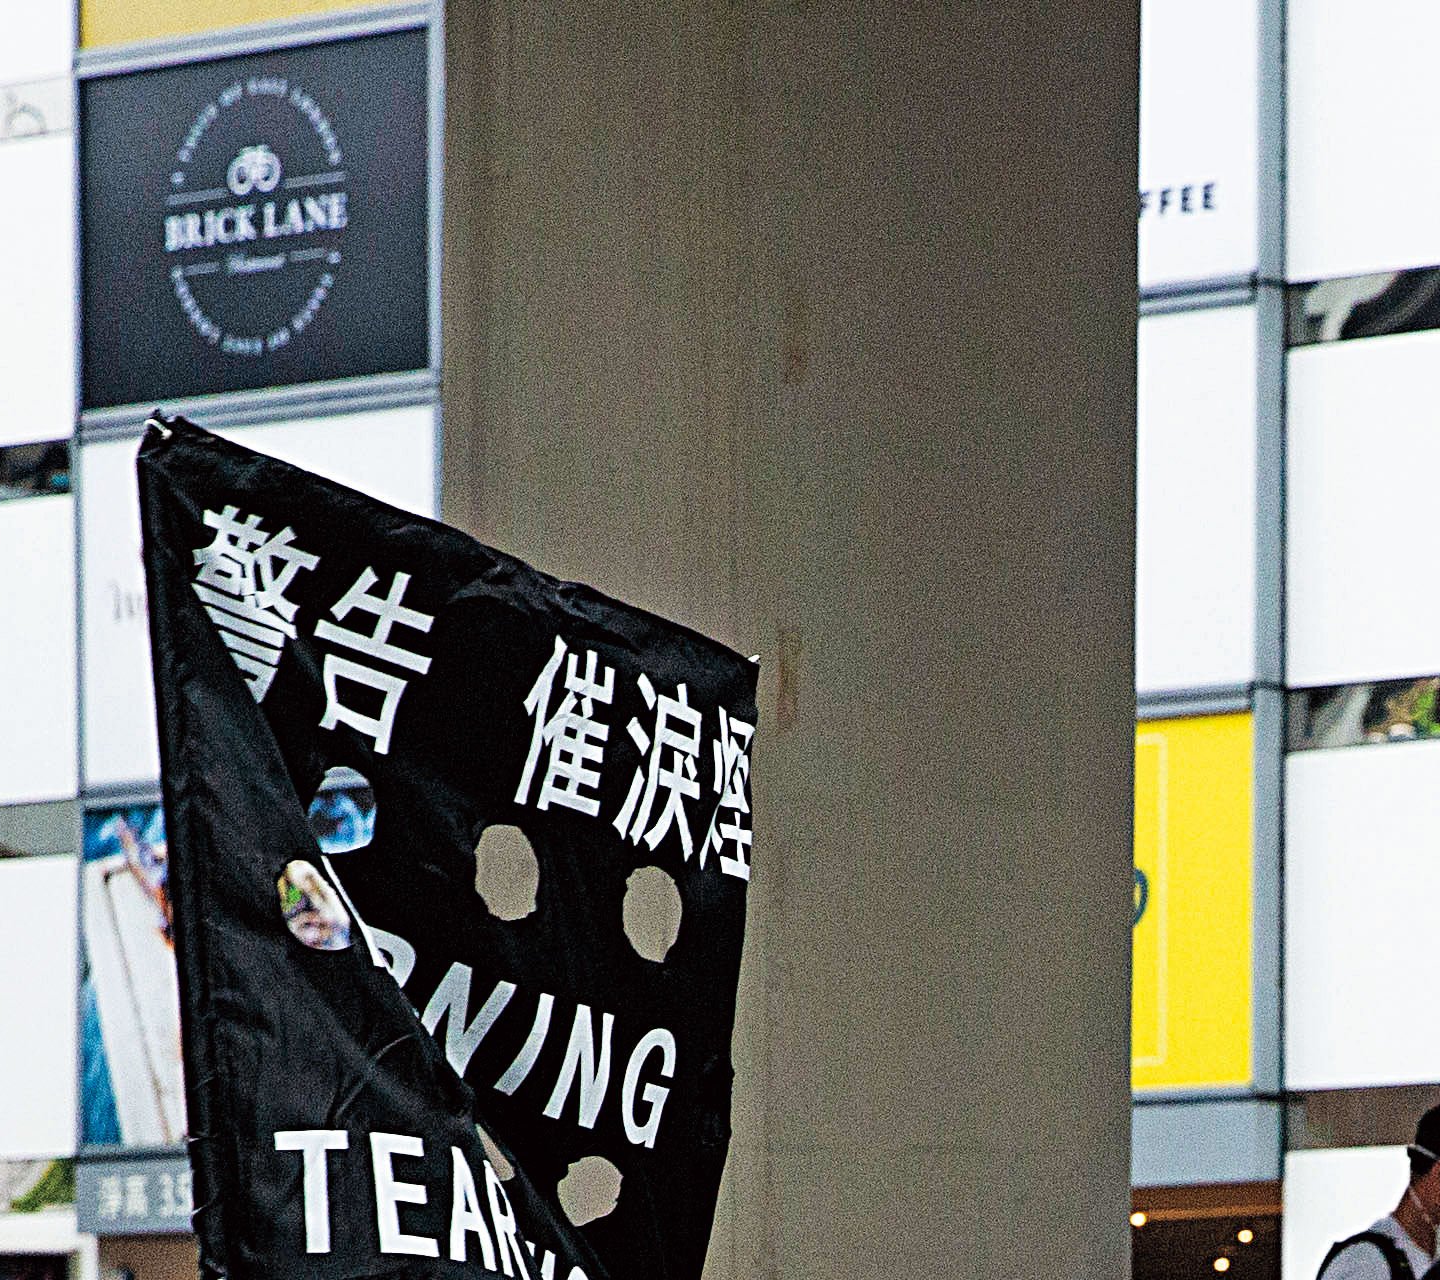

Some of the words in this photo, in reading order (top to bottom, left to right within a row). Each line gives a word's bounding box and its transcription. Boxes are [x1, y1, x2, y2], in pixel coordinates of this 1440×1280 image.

[164, 204, 256, 250] BRICK
[263, 192, 348, 238] LANE
[193, 505, 435, 756] 警告
